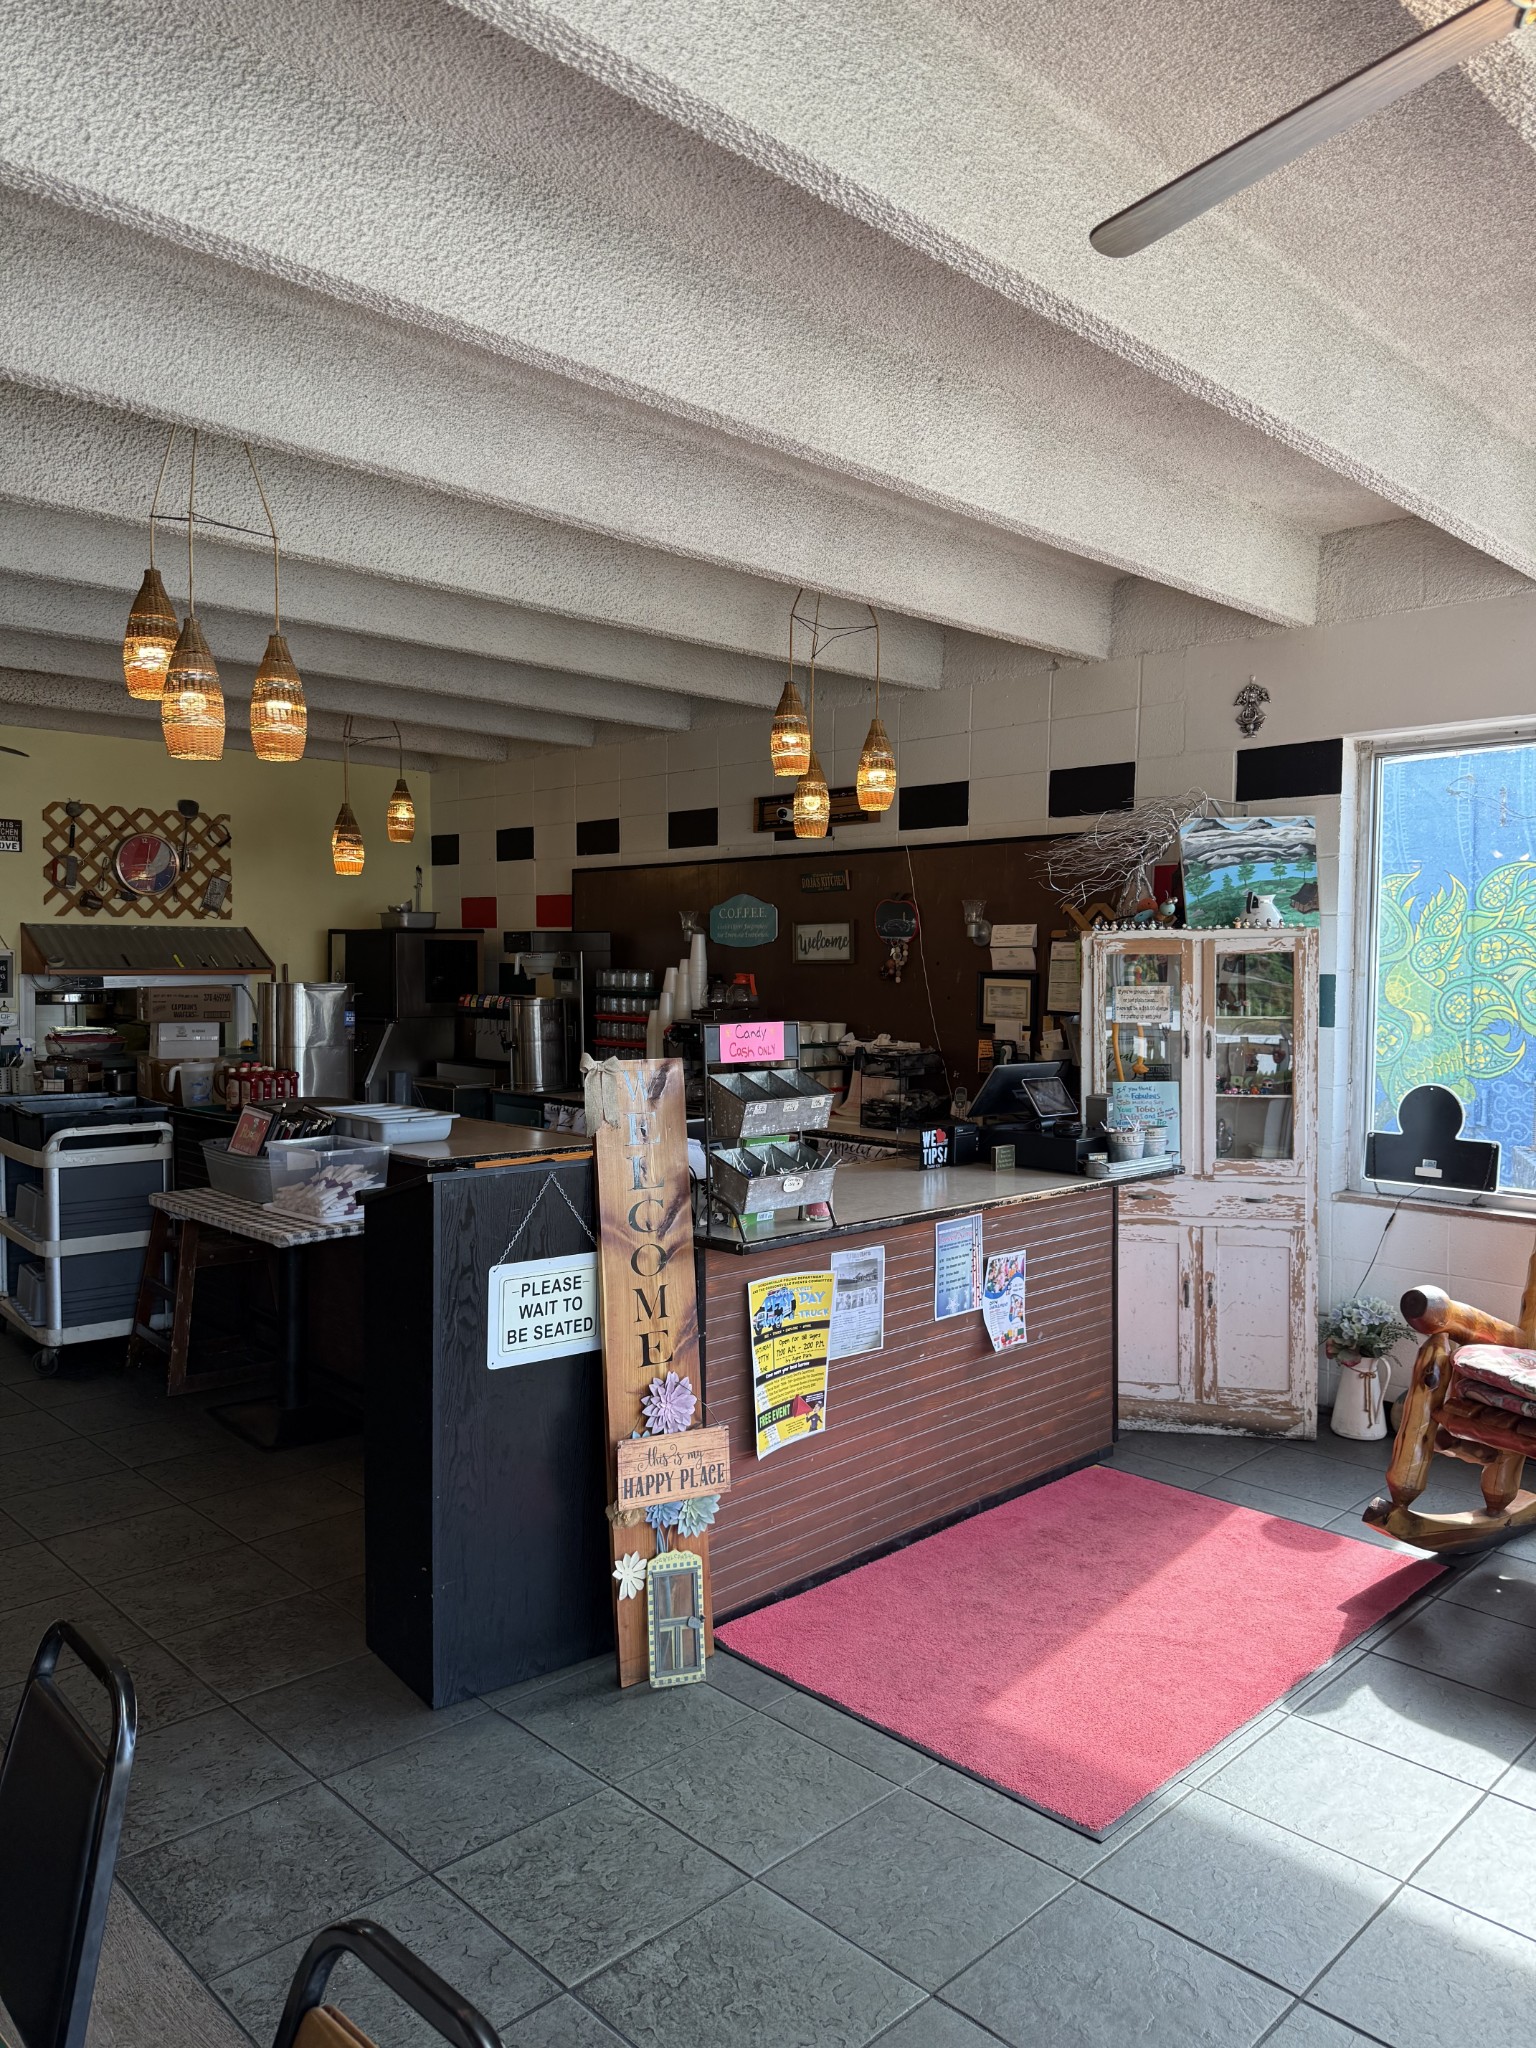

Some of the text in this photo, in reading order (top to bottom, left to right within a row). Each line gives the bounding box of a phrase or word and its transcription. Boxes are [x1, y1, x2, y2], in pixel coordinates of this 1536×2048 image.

[797, 929, 849, 954] Welcome
[735, 1024, 767, 1041] Candy
[729, 1042, 776, 1058] Cash ONLY
[922, 1129, 937, 1148] WE
[923, 1146, 949, 1166] TIPS!
[621, 1070, 674, 1369] WELCOME
[520, 1275, 582, 1298] PLEASE
[798, 1291, 826, 1305] DAY
[519, 1296, 583, 1320] WAIT TO
[507, 1316, 593, 1345] BE SEATED
[759, 1414, 772, 1428] FREE
[772, 1403, 791, 1421] EVENT
[637, 1446, 669, 1472] this
[687, 1450, 704, 1470] my
[623, 1462, 725, 1500] HAPPY PLACE
